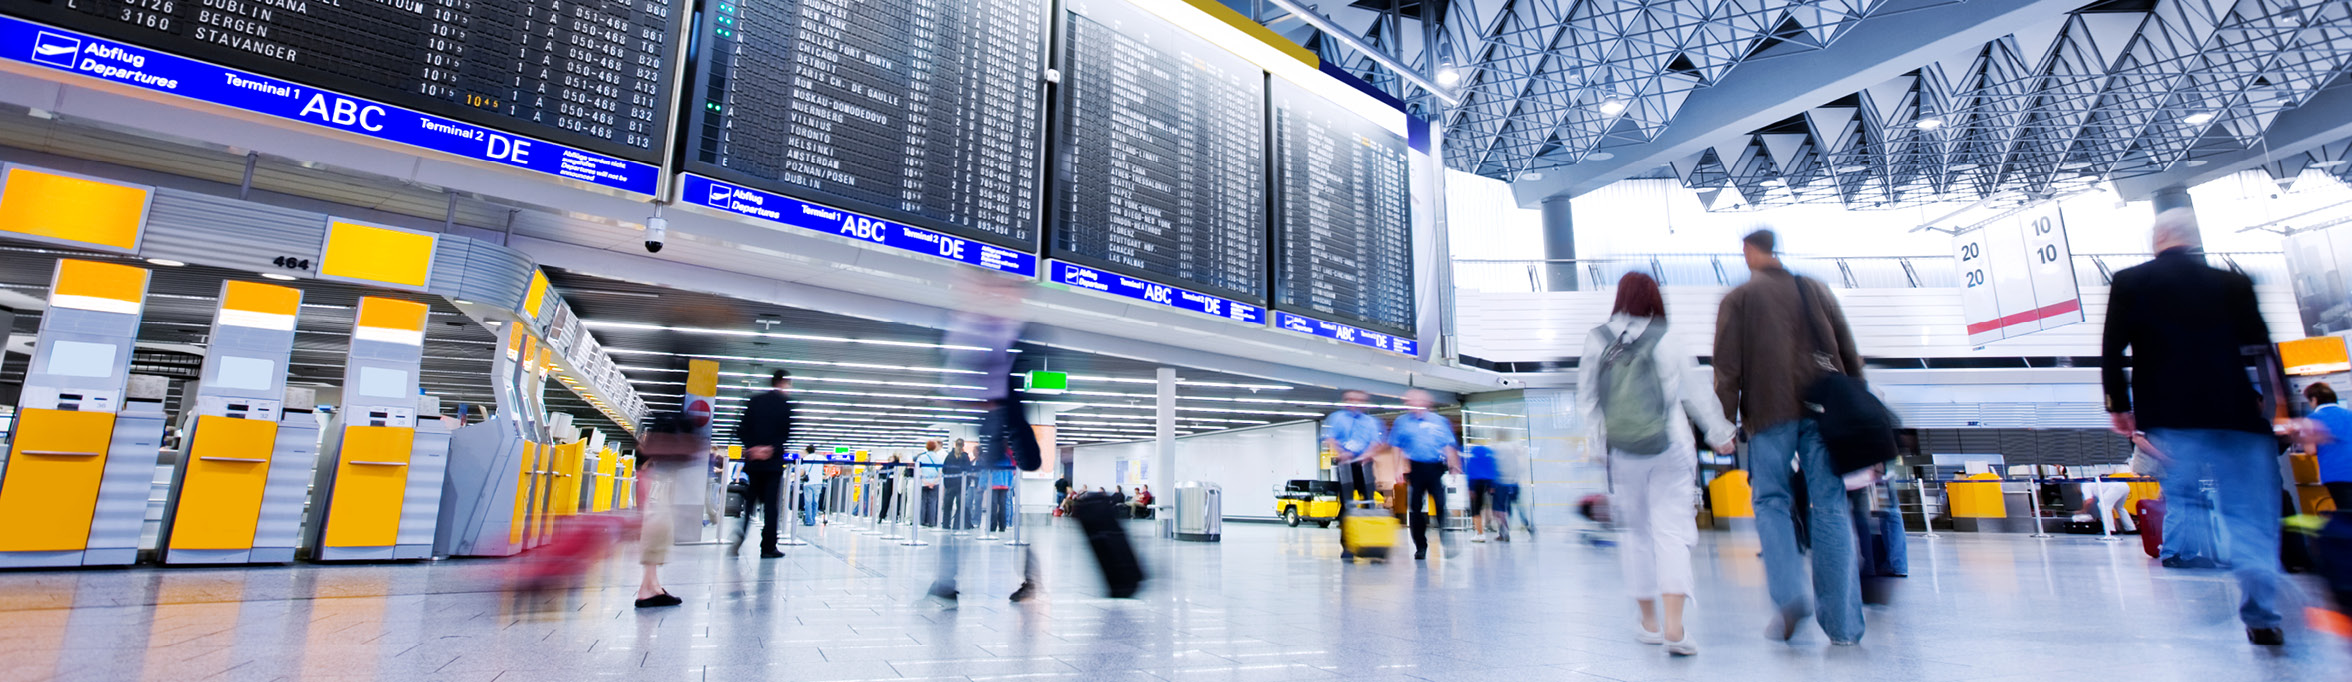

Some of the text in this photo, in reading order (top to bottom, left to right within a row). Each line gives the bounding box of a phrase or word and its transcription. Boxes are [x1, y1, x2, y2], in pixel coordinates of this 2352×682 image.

[646, 3, 667, 18] B60
[825, 14, 848, 31] YORK
[549, 14, 558, 24] A
[573, 21, 627, 45] 050-468
[641, 41, 655, 54] T6
[575, 7, 629, 32] 051-468
[642, 29, 663, 43] B61
[800, 19, 841, 41] KOLKATA
[547, 27, 555, 38] A
[571, 34, 625, 59] 050-468
[638, 55, 660, 69] B20
[799, 31, 835, 50] DALLAS
[83, 42, 146, 69] Abflug
[544, 41, 553, 52] A
[569, 48, 623, 72] 050-468
[636, 68, 658, 82] B23
[796, 54, 838, 75] DETROIT
[798, 43, 839, 64] CHICAGO
[79, 57, 179, 90] Departures
[120, 8, 170, 31] 3160
[194, 27, 298, 62] STAVANGER
[532, 111, 542, 122] A
[558, 117, 612, 139] 050-468
[626, 134, 649, 148] B13
[199, 10, 268, 37] BERGEN
[534, 97, 544, 108] A
[560, 103, 614, 126] 050-468
[628, 121, 643, 133] B1
[542, 55, 551, 66] A
[566, 62, 620, 85] 050-468
[634, 81, 656, 95] A13
[224, 72, 301, 100] Terminal 1
[539, 69, 549, 80] A
[564, 75, 618, 98] 051-468
[632, 94, 654, 108] B11
[795, 66, 825, 83] PARIS
[867, 85, 900, 106] GAULLE
[299, 92, 387, 133] ABC
[537, 82, 546, 93] A
[562, 89, 616, 112] 050-468
[630, 107, 653, 121] B32
[791, 101, 844, 124] NUERNBERG
[420, 117, 485, 142] Terminal 2
[789, 124, 831, 144] TORONTO
[790, 113, 833, 132] VILNIUS
[486, 133, 532, 165] DE
[787, 137, 835, 157] HELSINKI
[786, 149, 840, 170] AMSTERDAM
[784, 172, 821, 190] DUBLIN
[785, 160, 856, 187] POZNAN/POSEN
[733, 189, 764, 206] Abflug
[731, 200, 780, 220] Departures
[801, 204, 837, 221] Terminal
[840, 215, 887, 244] ABC
[902, 227, 934, 242] Terminal
[1961, 215, 2052, 262] 20 10
[939, 236, 965, 260] DE
[273, 255, 309, 270] 464
[1966, 243, 2058, 288] 20 10
[1144, 283, 1173, 304] ABC
[1204, 297, 1221, 315] DE
[1335, 325, 1355, 342] ABC
